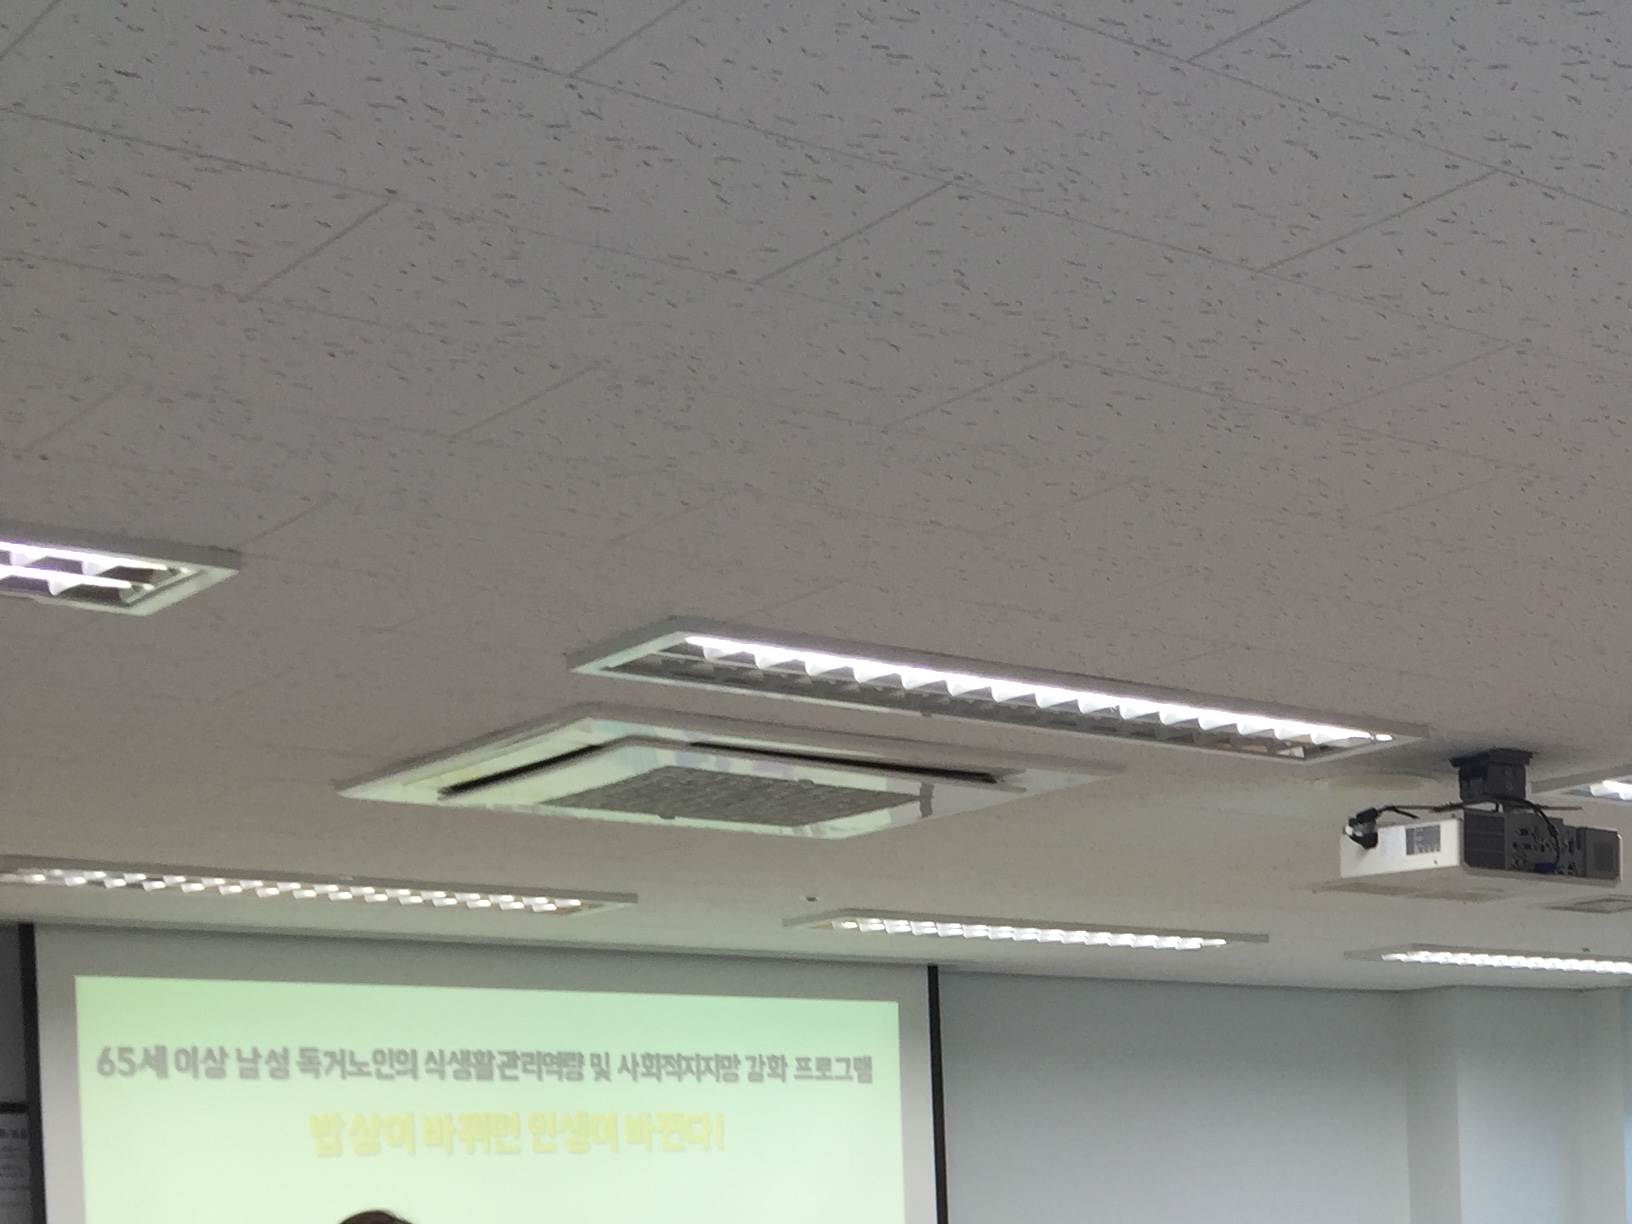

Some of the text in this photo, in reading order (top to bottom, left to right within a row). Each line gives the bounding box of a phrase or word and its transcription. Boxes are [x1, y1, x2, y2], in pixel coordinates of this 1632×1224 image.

[97, 1045, 168, 1079] 65세
[174, 1046, 229, 1080] 이상
[235, 1047, 291, 1081] 남성
[297, 1047, 419, 1081] 독거노인의
[590, 1052, 612, 1083] 및
[745, 1055, 788, 1083] 강화
[794, 1055, 873, 1084] 프로그램
[309, 1112, 416, 1157] 밥상이
[528, 1111, 618, 1154] 인생이
